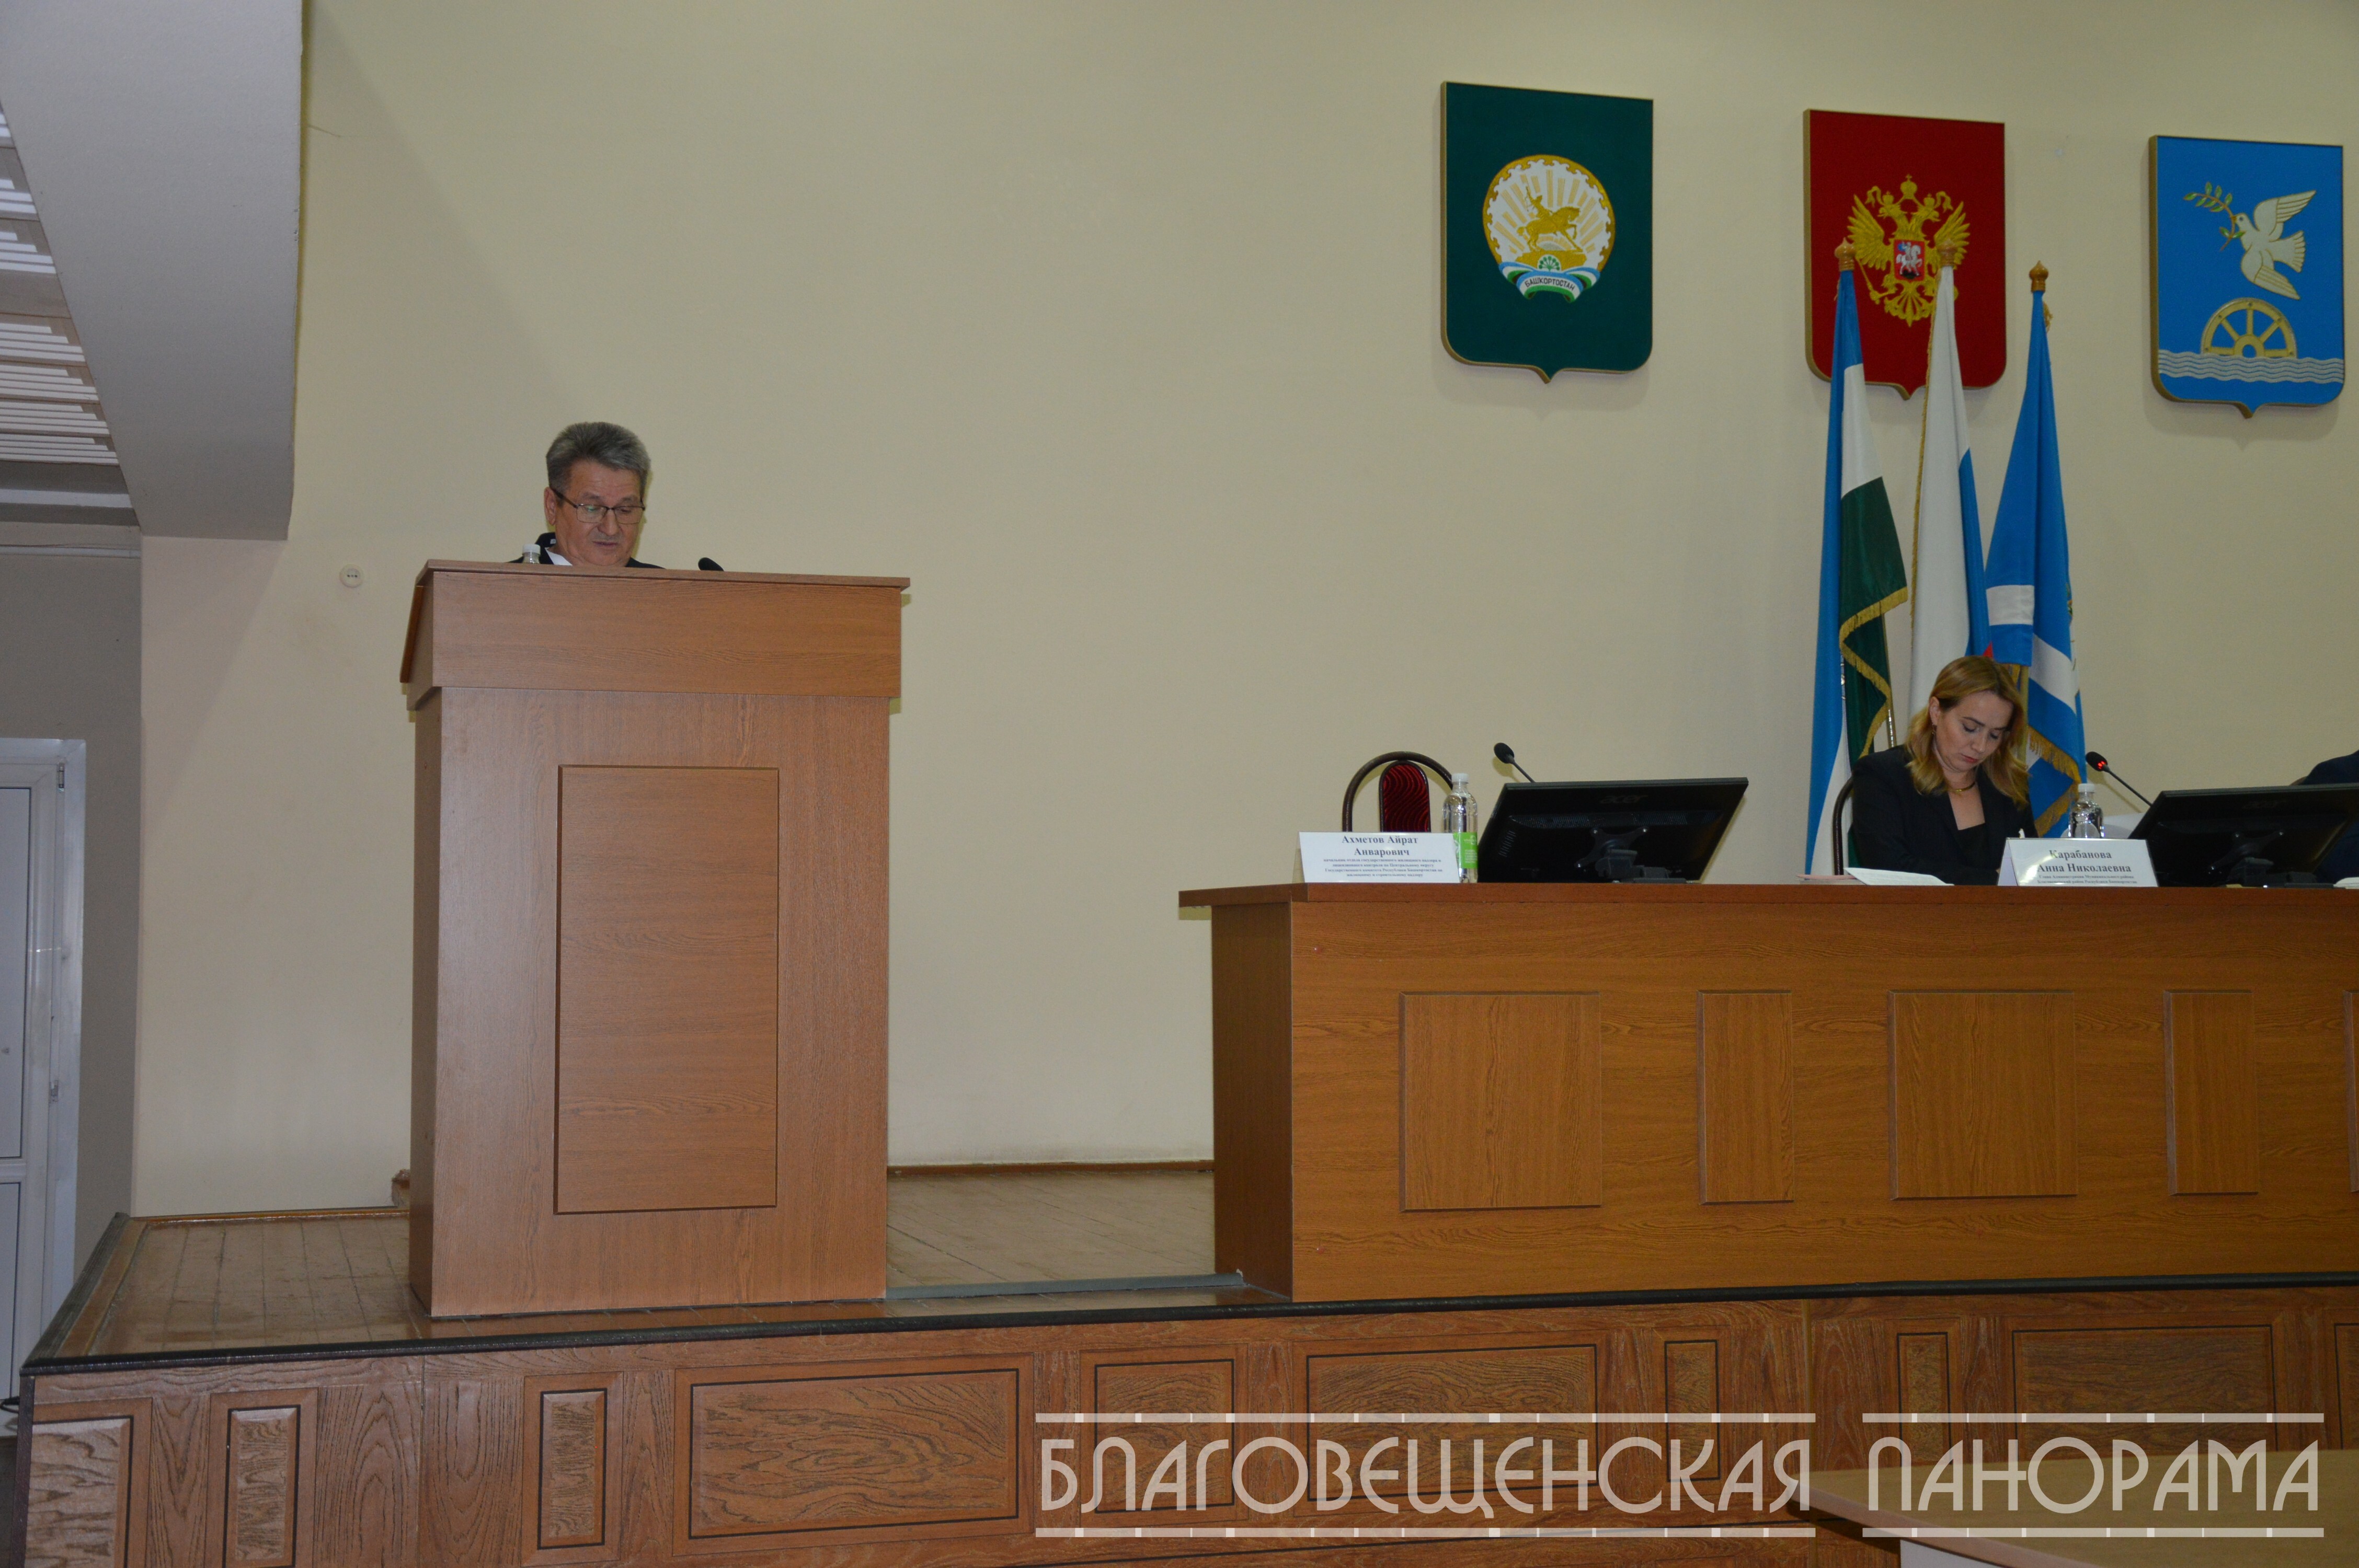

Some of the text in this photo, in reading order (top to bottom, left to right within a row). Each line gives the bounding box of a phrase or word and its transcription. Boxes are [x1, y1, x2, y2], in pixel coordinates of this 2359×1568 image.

[1525, 277, 1575, 291] БАШКОРТОСТАН
[1388, 836, 1418, 846] Айрат
[1354, 848, 1410, 857] Анварович
[2049, 850, 2112, 861] Карабанова
[2067, 863, 2131, 872] Николаевна
